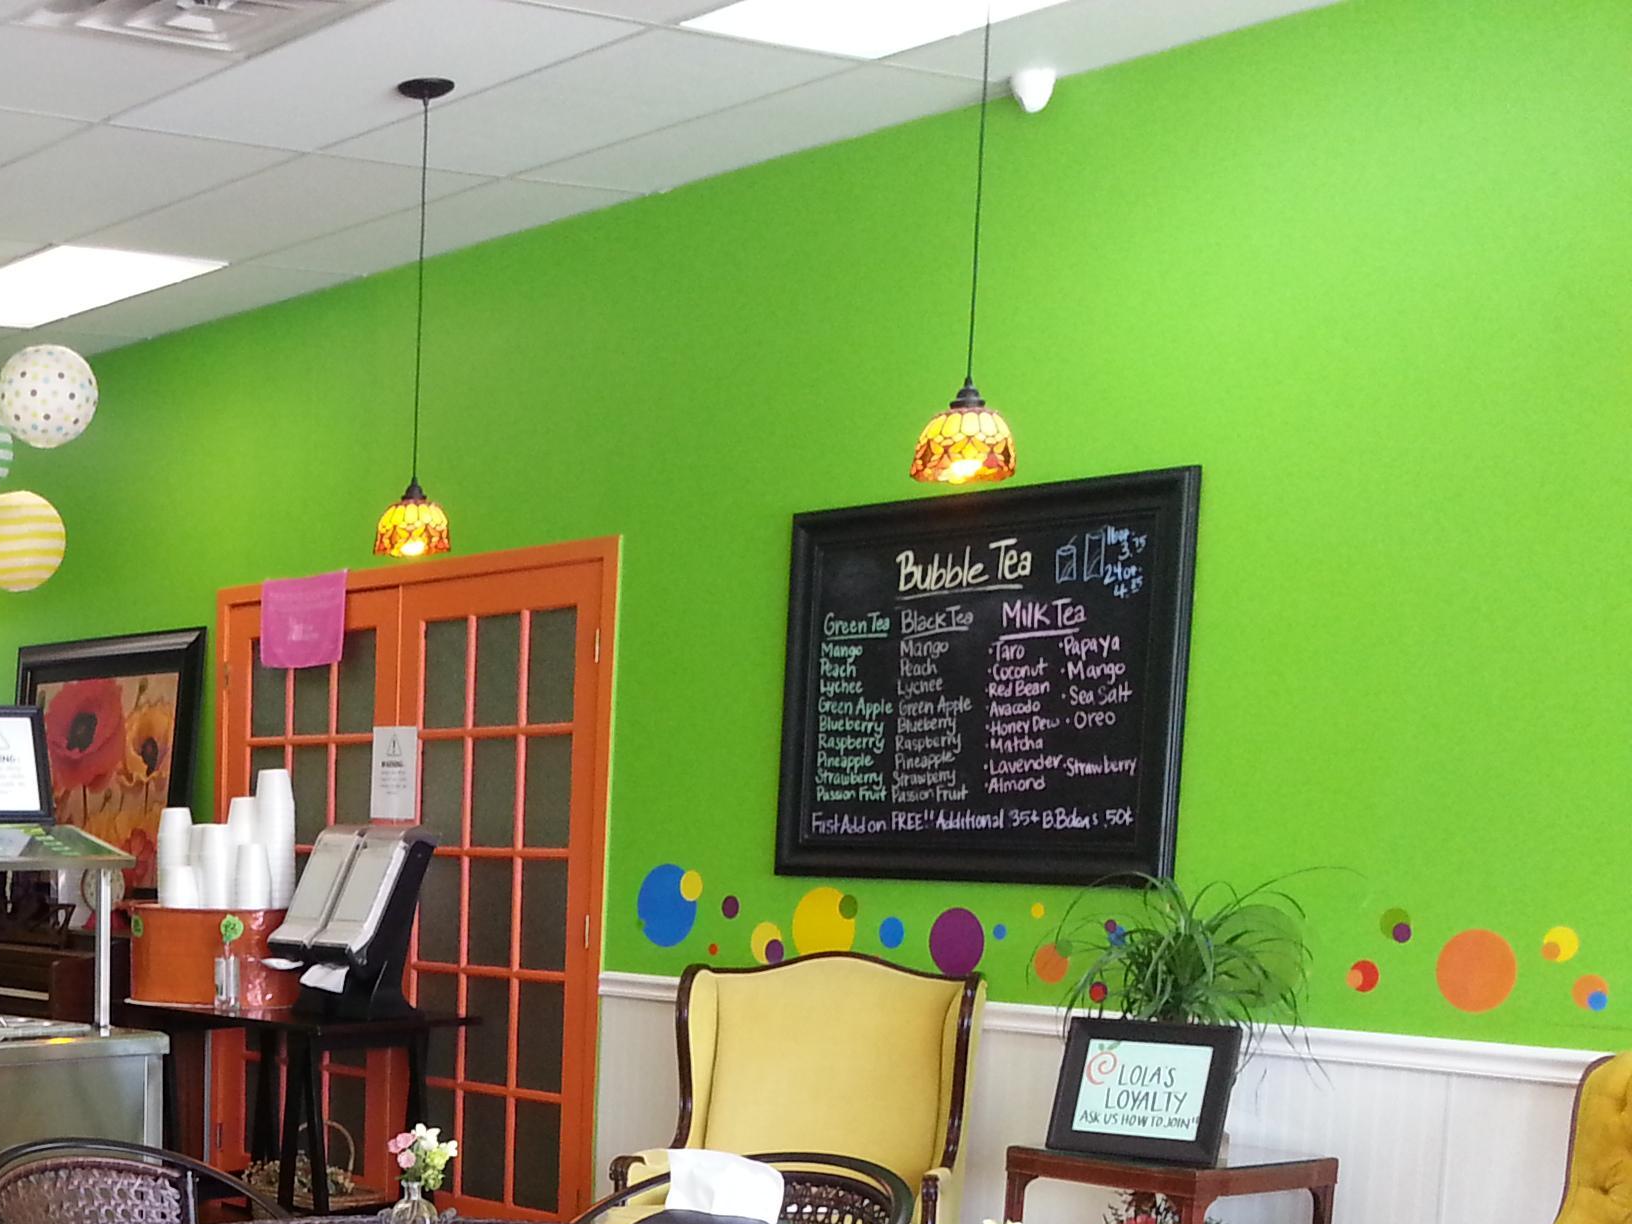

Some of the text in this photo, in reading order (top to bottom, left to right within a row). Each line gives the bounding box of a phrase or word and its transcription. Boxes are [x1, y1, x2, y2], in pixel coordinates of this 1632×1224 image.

[896, 538, 1032, 592] Bubble Tea
[824, 611, 890, 636] Green Tea
[900, 605, 974, 634] Black Tea
[1002, 598, 1087, 629] Milk Tea
[821, 642, 864, 664] Mango
[900, 640, 949, 659] Mango
[992, 641, 1025, 661] Taro
[1063, 634, 1120, 661] Papaya
[820, 658, 857, 678] Peach
[900, 658, 938, 677] Peach
[992, 657, 1049, 681] Coconut
[1067, 660, 1126, 685] Mango
[820, 678, 864, 697] Lychee
[897, 677, 944, 699] Lychee
[989, 681, 1050, 698] Red Bean
[1069, 681, 1133, 706] Sea Salt
[818, 697, 894, 720] Green Apple
[898, 695, 973, 717] Green Apple
[990, 699, 1041, 718] Avacodo
[819, 714, 885, 738] Blueberry
[897, 715, 957, 736] Blueberry
[990, 716, 1060, 736] Honey Dew
[1074, 711, 1116, 729] Oreo
[818, 733, 886, 755] Raspberry
[895, 733, 962, 754] Raspberry
[991, 735, 1044, 753] Matcha
[817, 751, 874, 773] Pineapple
[894, 751, 956, 771] Pineapple
[989, 754, 1063, 775] Lavender
[1065, 755, 1137, 777] Strawberry
[815, 768, 884, 790] Strawberry
[893, 769, 956, 788] Strawberry
[988, 775, 1045, 794] Almond
[816, 786, 887, 802] Passion Fruit
[892, 784, 969, 803] Passion Fruit
[840, 814, 865, 834] Add
[867, 820, 887, 833] on
[935, 808, 1004, 831] Additional
[1118, 1064, 1177, 1088] LOLA'S
[1105, 1088, 1188, 1114] LOYALTY
[1079, 1110, 1100, 1124] ASK
[1103, 1113, 1119, 1125] US
[1121, 1114, 1148, 1127] HOW
[1150, 1116, 1163, 1128] TO
